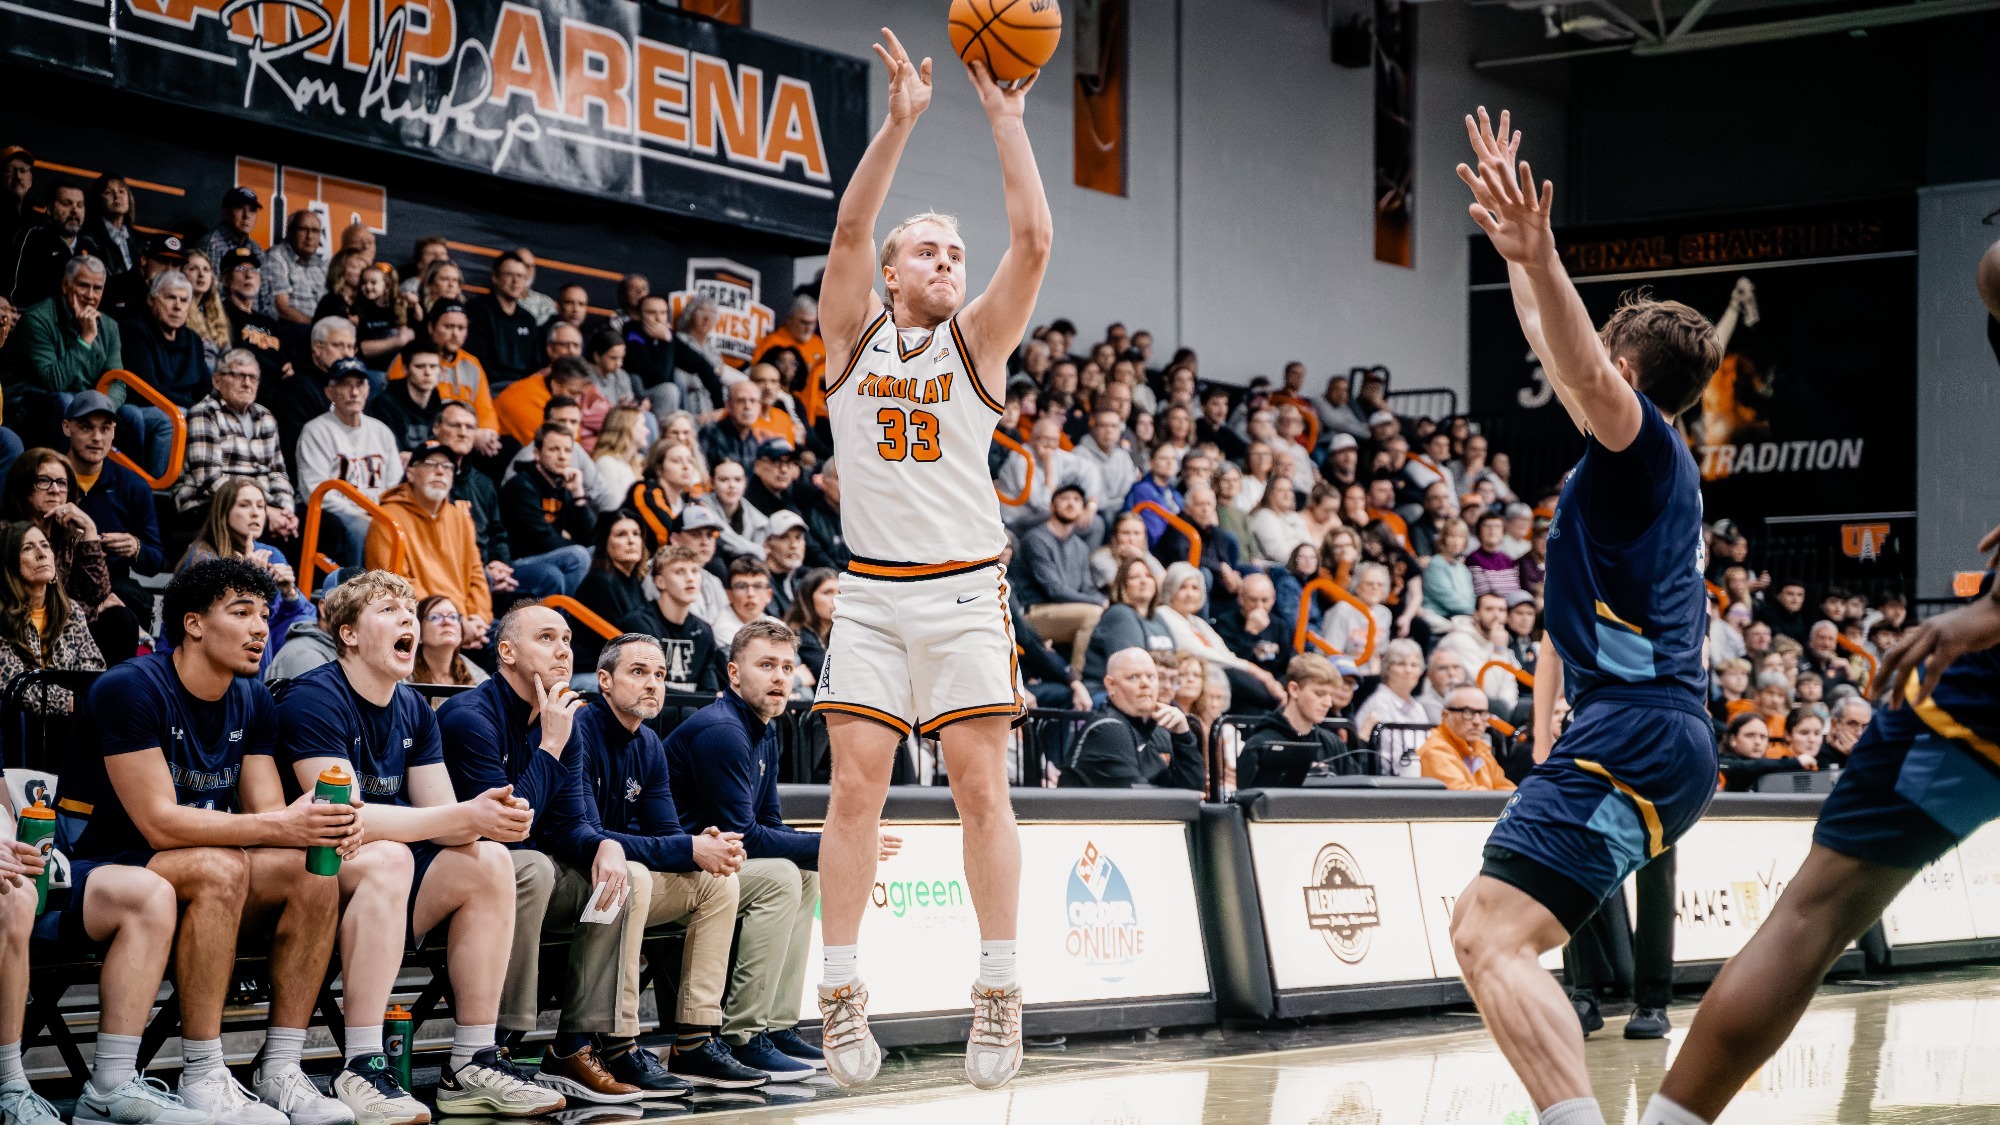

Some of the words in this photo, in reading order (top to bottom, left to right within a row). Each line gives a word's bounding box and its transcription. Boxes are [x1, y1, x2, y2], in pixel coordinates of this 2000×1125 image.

[484, 2, 832, 184] ARENA
[876, 407, 943, 462] 33
[1700, 437, 1864, 476] TRADITION
[868, 879, 964, 918] agreen
[1068, 901, 1136, 926] ORDER
[1065, 926, 1145, 960] ONLINE
